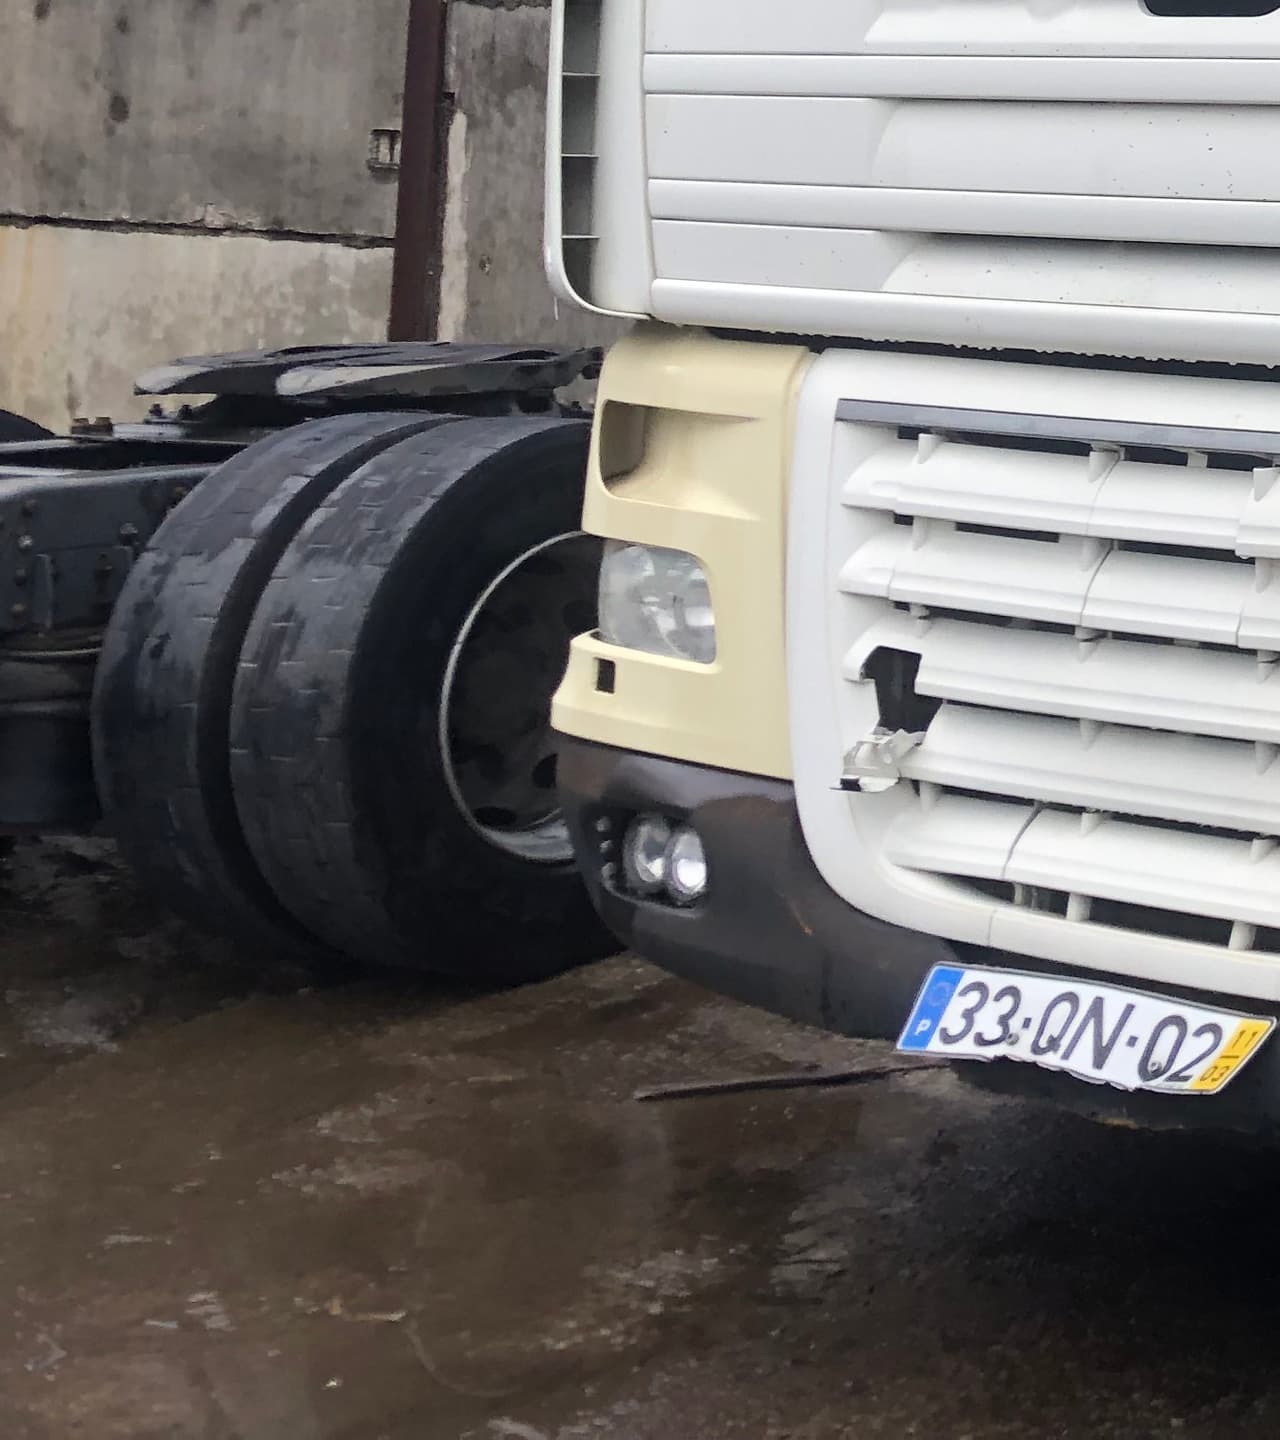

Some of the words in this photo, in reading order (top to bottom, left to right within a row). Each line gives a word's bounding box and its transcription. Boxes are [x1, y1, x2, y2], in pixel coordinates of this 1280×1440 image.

[914, 1020, 932, 1036] P
[1231, 1029, 1258, 1049] 11
[1199, 1065, 1230, 1082] 03
